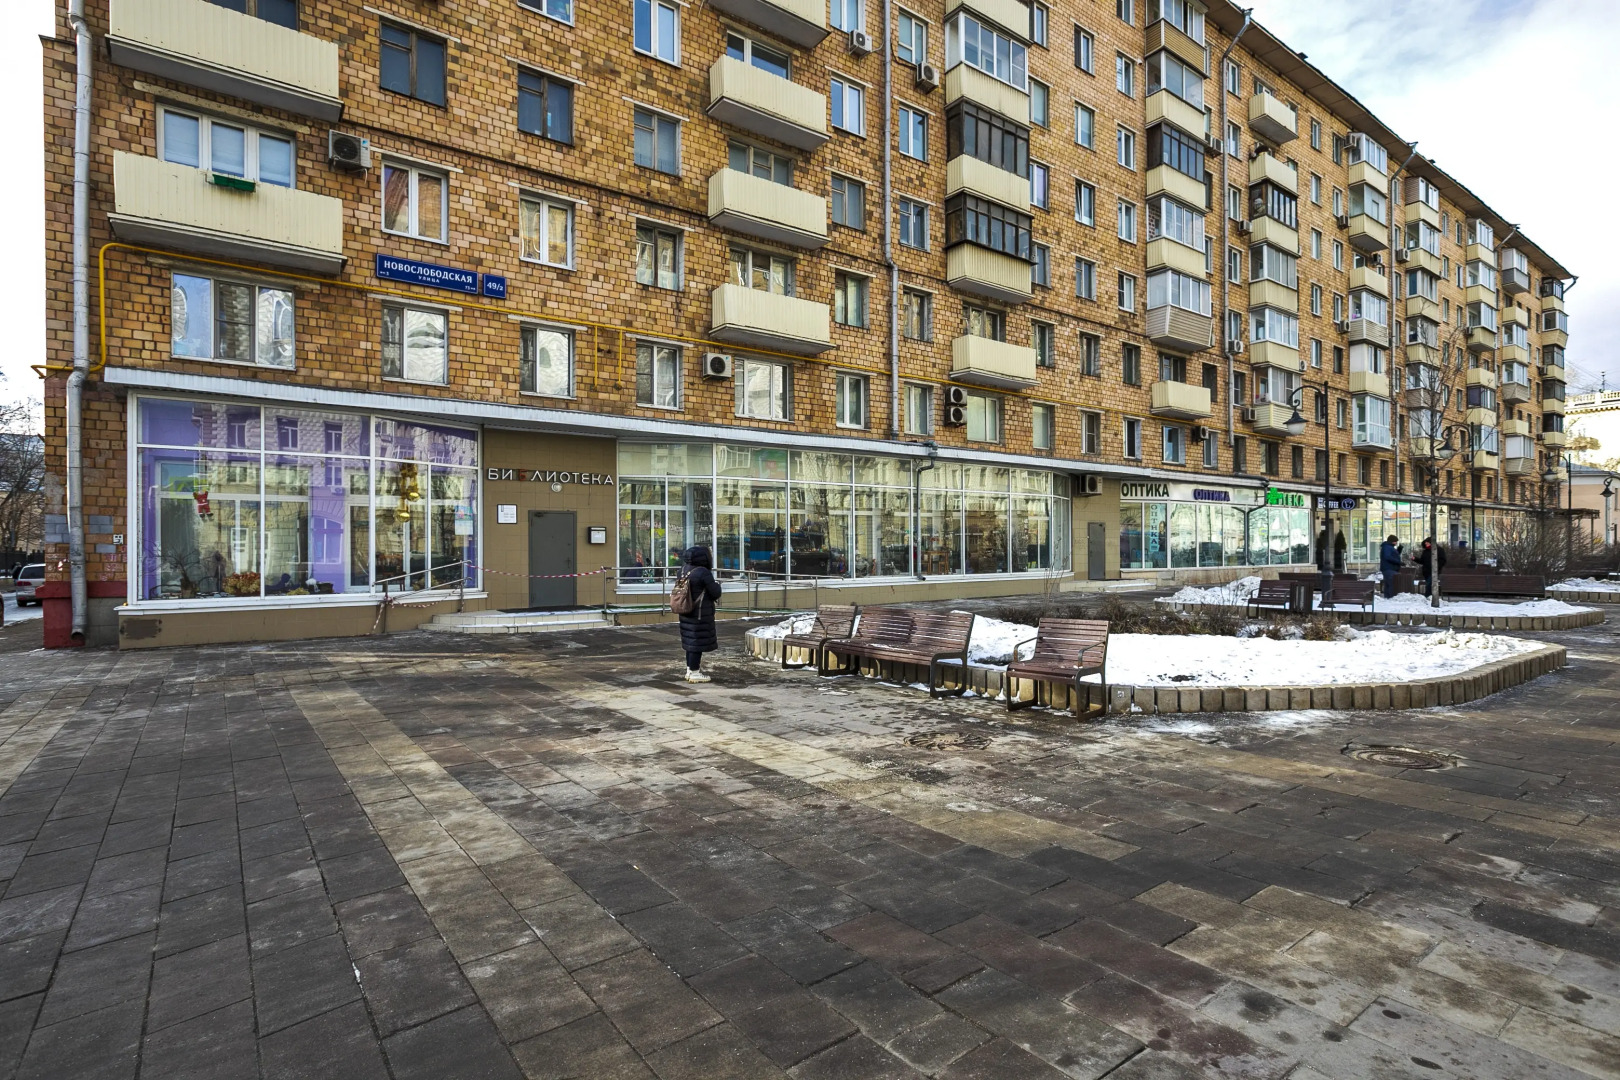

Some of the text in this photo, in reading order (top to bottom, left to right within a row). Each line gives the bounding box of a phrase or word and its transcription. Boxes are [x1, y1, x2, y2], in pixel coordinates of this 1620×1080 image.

[384, 260, 473, 284] НОВОСЛОБОДСКАЯ
[418, 275, 440, 284] УЛИЦА
[486, 281, 504, 291] 49/2
[488, 468, 614, 486] БИБЛИОТЕКА
[1121, 482, 1170, 498] ОПТИКА
[1193, 488, 1231, 502] ОПТИКА
